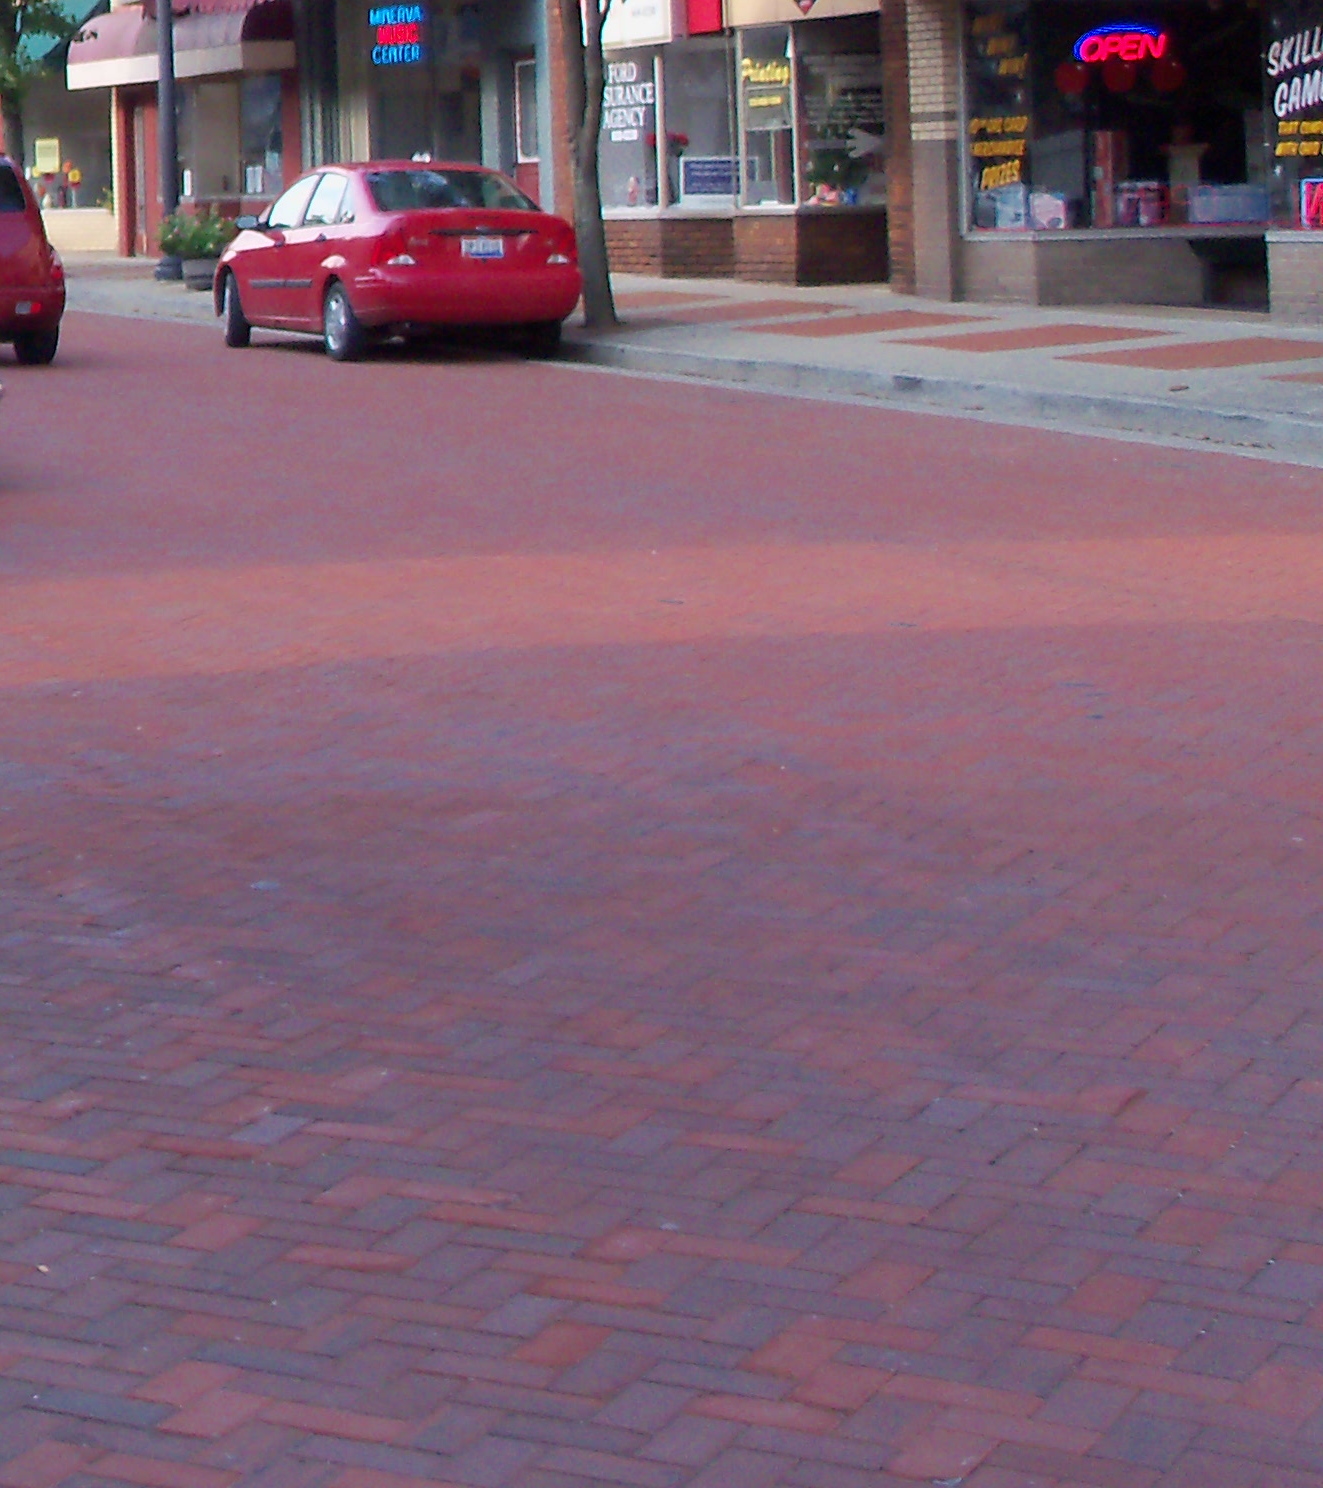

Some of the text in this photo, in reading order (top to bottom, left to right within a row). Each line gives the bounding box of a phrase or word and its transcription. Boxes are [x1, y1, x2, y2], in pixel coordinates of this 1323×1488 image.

[369, 5, 422, 26] MINERVA
[377, 22, 419, 45] MUSIC
[371, 43, 420, 65] CENTER
[1079, 31, 1167, 63] OPEN
[1266, 25, 1323, 76] SKILL
[602, 81, 655, 108] SURANCE
[602, 105, 646, 130] AGENCY
